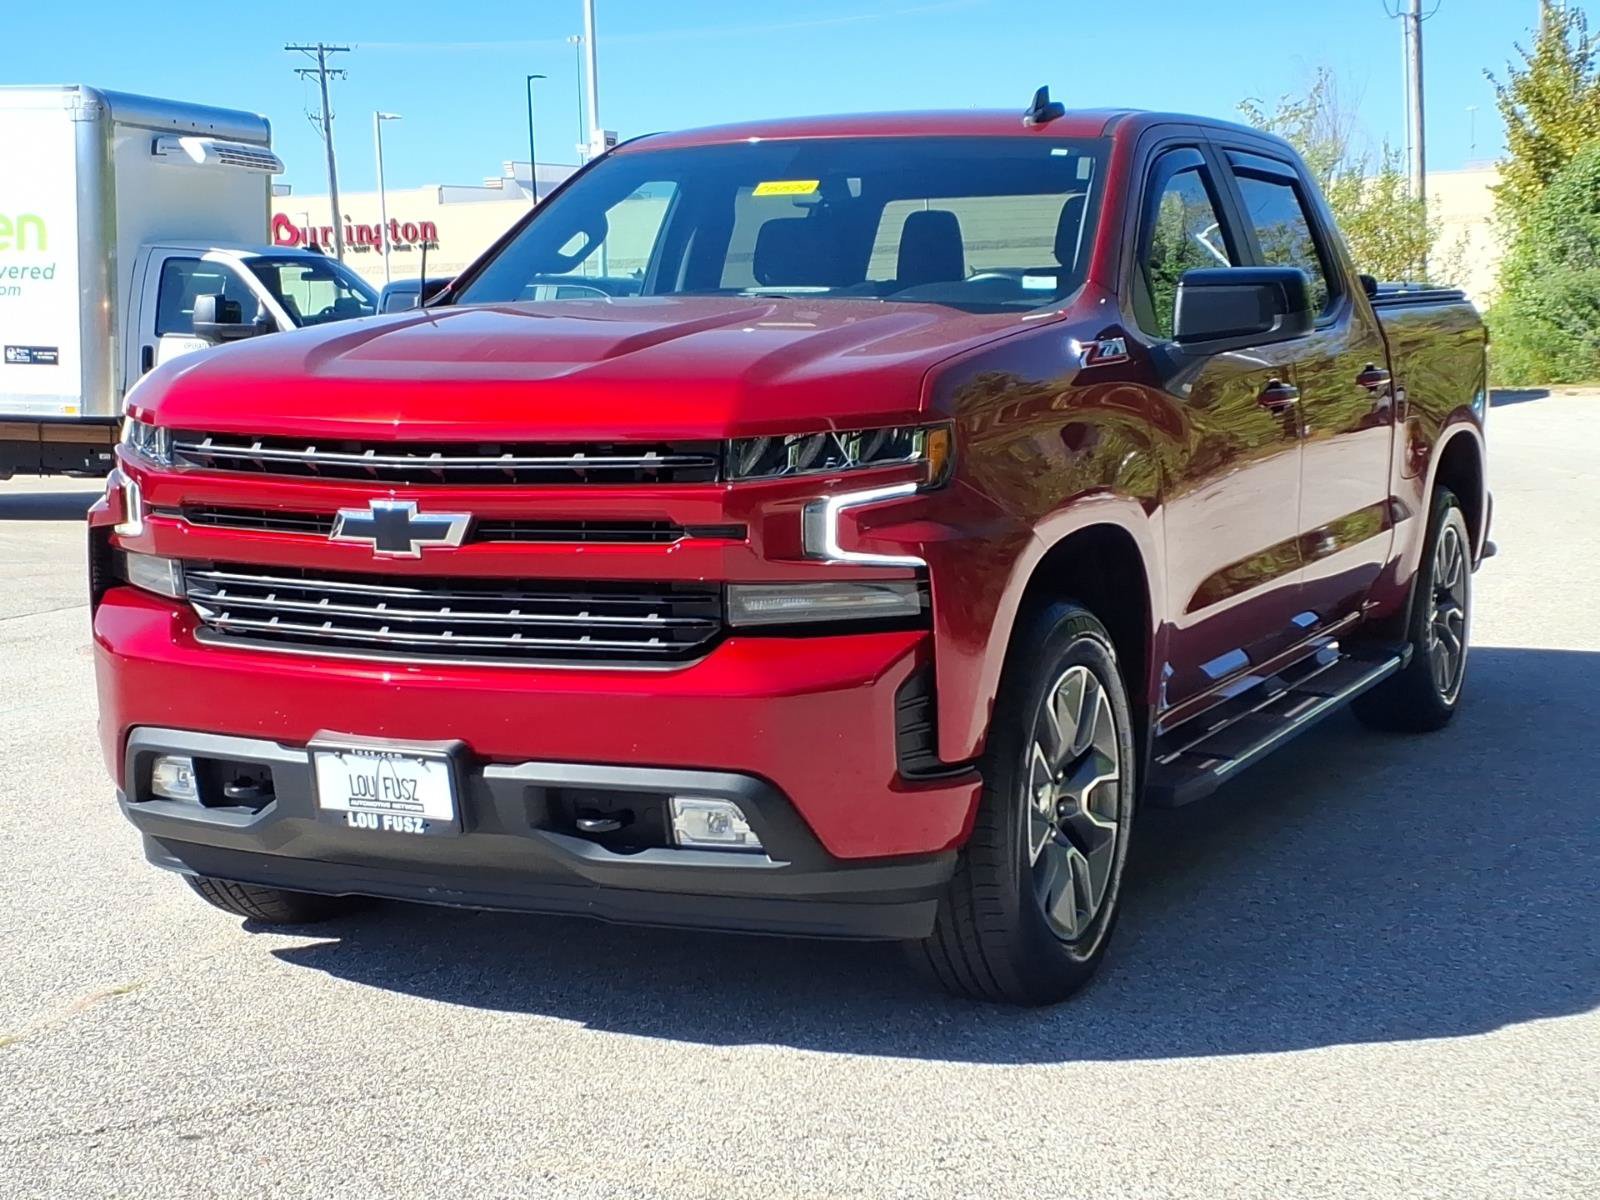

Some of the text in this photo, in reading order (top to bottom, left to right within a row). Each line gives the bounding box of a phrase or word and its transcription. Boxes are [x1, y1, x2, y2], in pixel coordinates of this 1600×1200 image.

[272, 213, 439, 256] Burington
[349, 774, 420, 801] LOU FUSZ
[347, 812, 425, 834] LOU FUSZ
